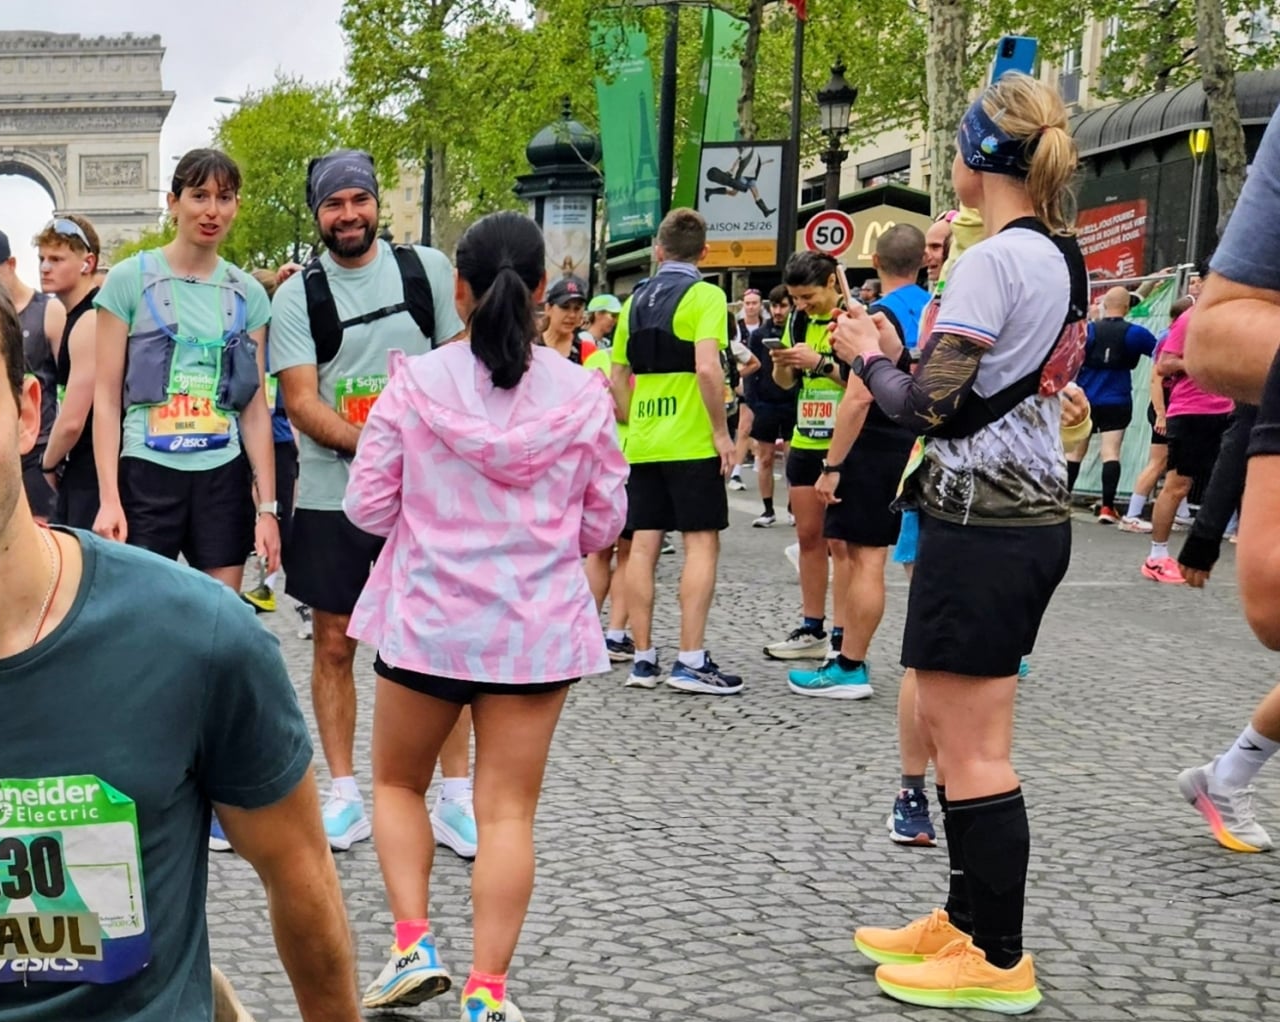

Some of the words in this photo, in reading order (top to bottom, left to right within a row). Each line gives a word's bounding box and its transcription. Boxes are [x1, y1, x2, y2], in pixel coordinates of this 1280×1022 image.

[743, 220, 773, 231] 25/26
[815, 226, 845, 246] 50
[16, 805, 99, 822] Electric
[394, 951, 421, 972] HOKA
